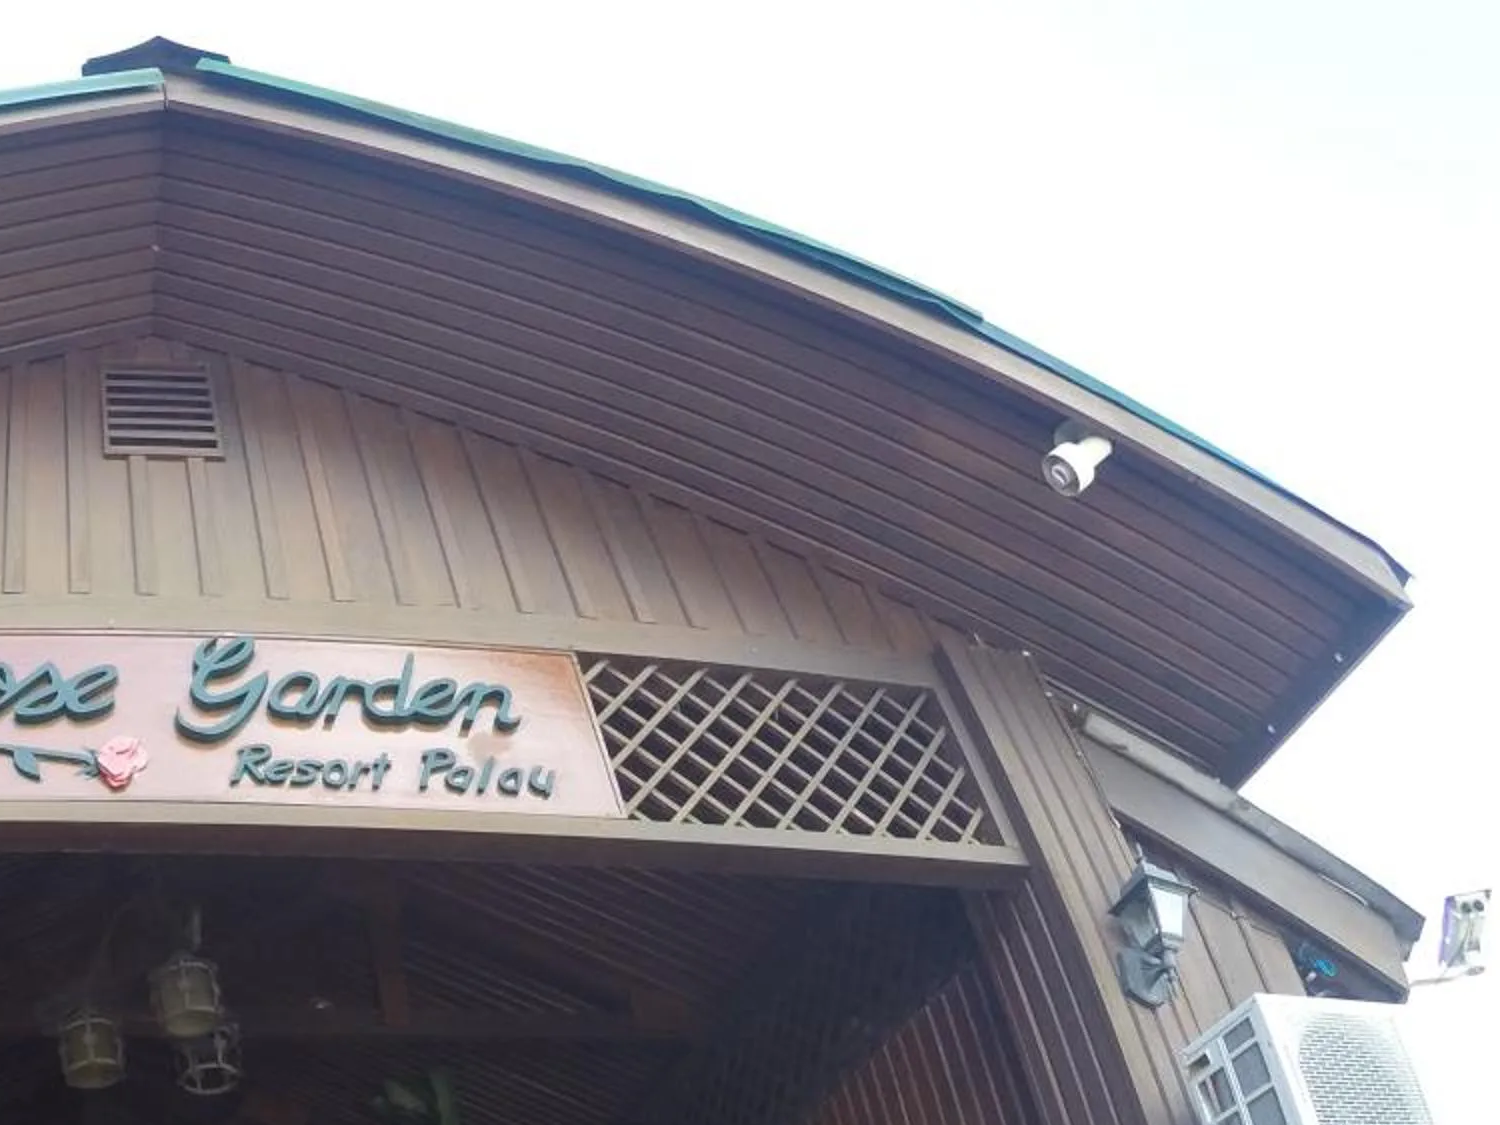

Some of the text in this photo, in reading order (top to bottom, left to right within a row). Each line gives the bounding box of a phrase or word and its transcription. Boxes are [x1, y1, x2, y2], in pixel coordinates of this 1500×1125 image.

[175, 637, 522, 742] Garden
[231, 744, 557, 799] Resort Palau
